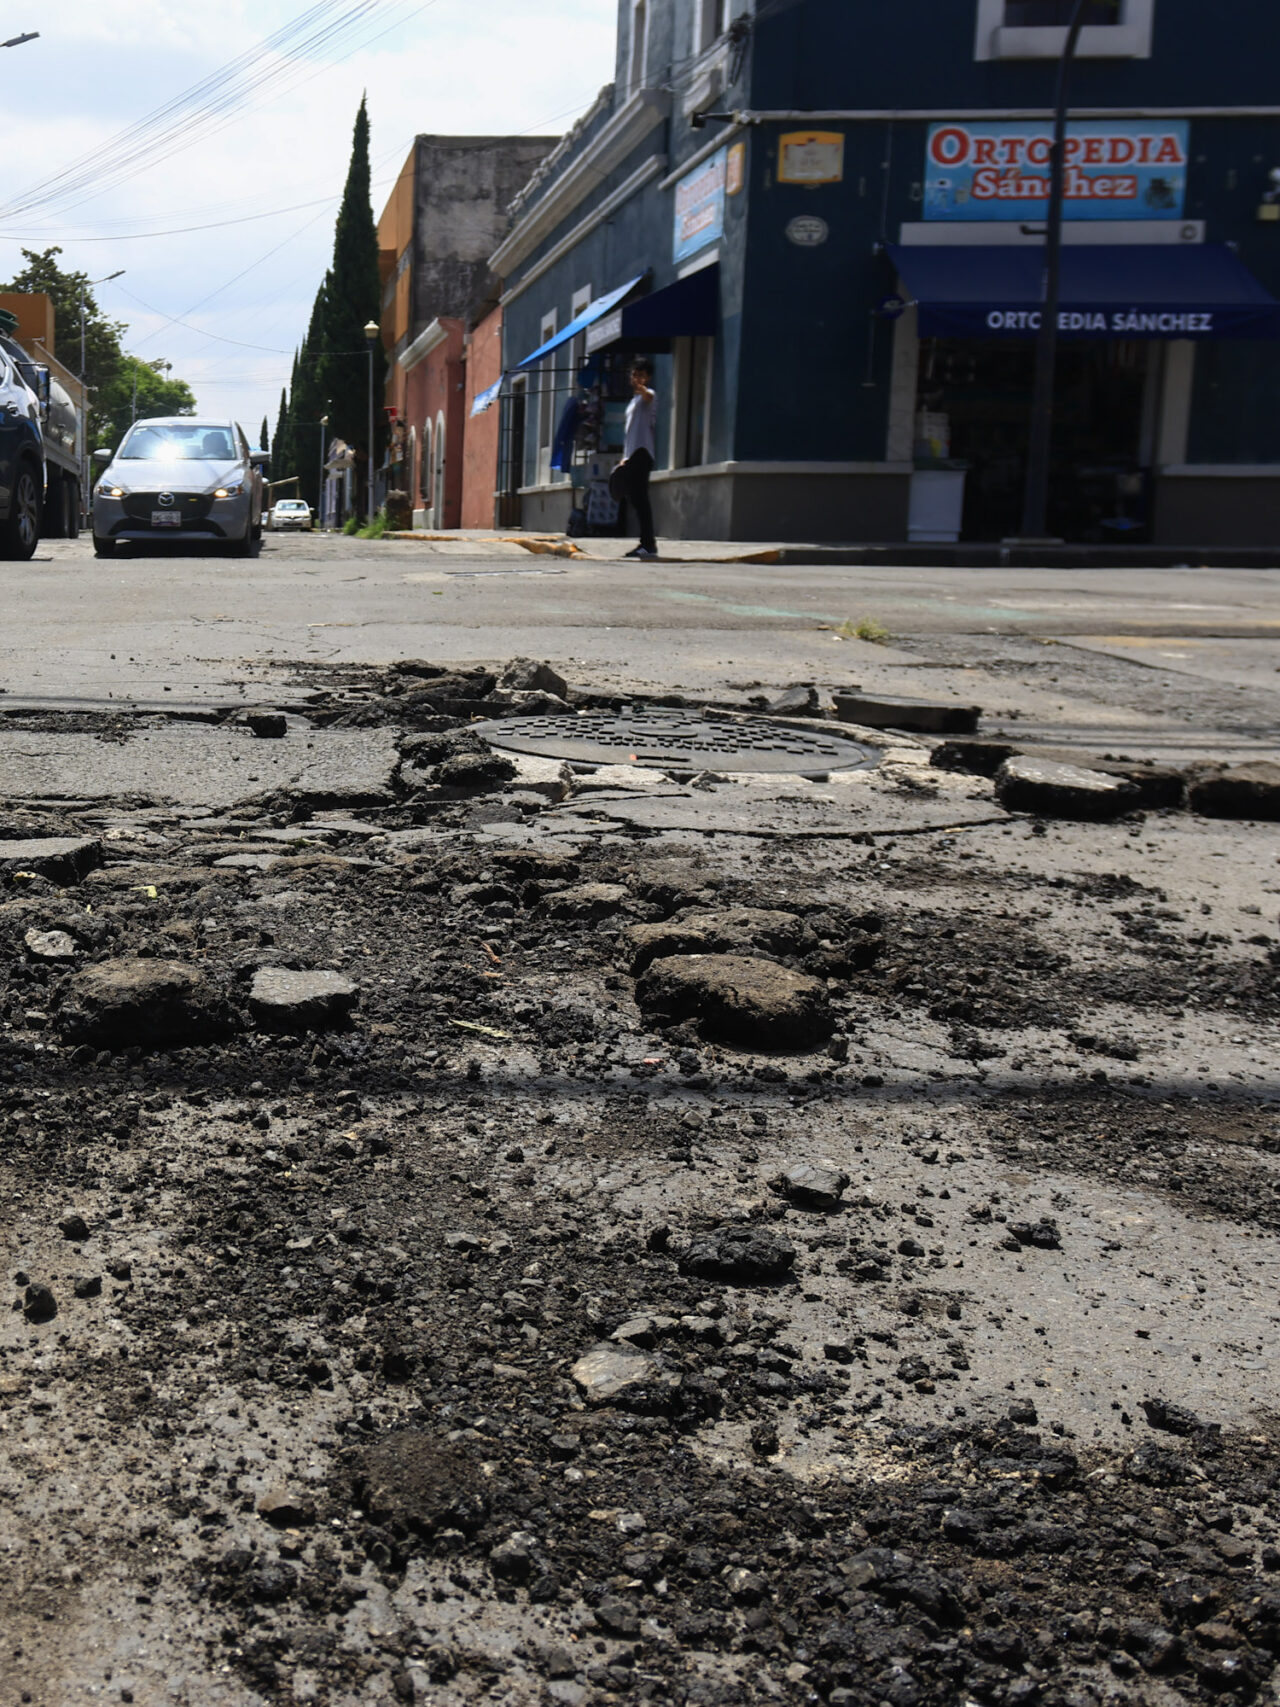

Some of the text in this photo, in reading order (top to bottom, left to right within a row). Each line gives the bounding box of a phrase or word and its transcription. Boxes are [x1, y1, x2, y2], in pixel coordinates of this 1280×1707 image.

[931, 128, 1185, 165] ORTOPEDIA
[973, 167, 1136, 198] Sánhez
[986, 307, 1214, 332] ORTOEDIA SÁNCHEZ
